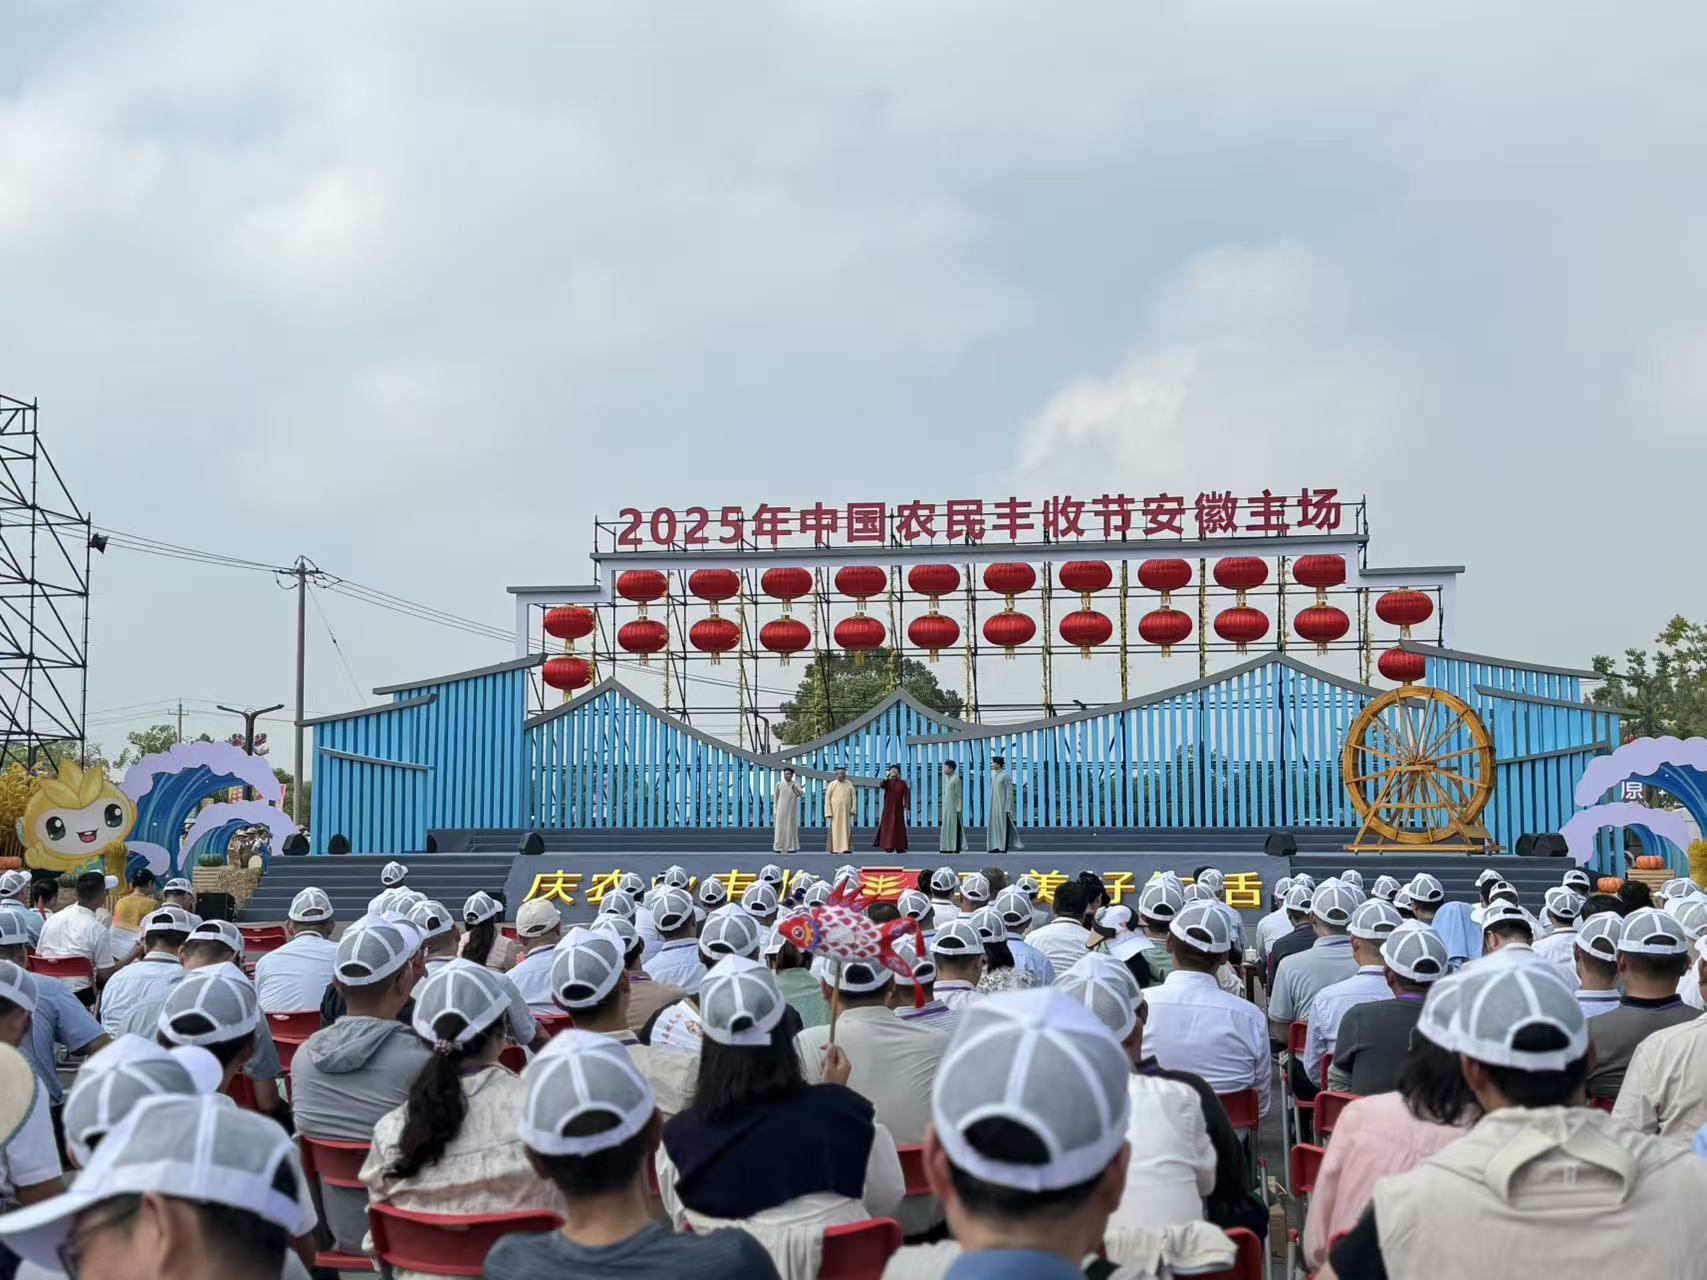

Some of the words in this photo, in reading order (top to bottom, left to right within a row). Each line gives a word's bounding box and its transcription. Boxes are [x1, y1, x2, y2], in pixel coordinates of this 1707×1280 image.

[617, 488, 1341, 546] 2025年中国农民丰收节安徽主场
